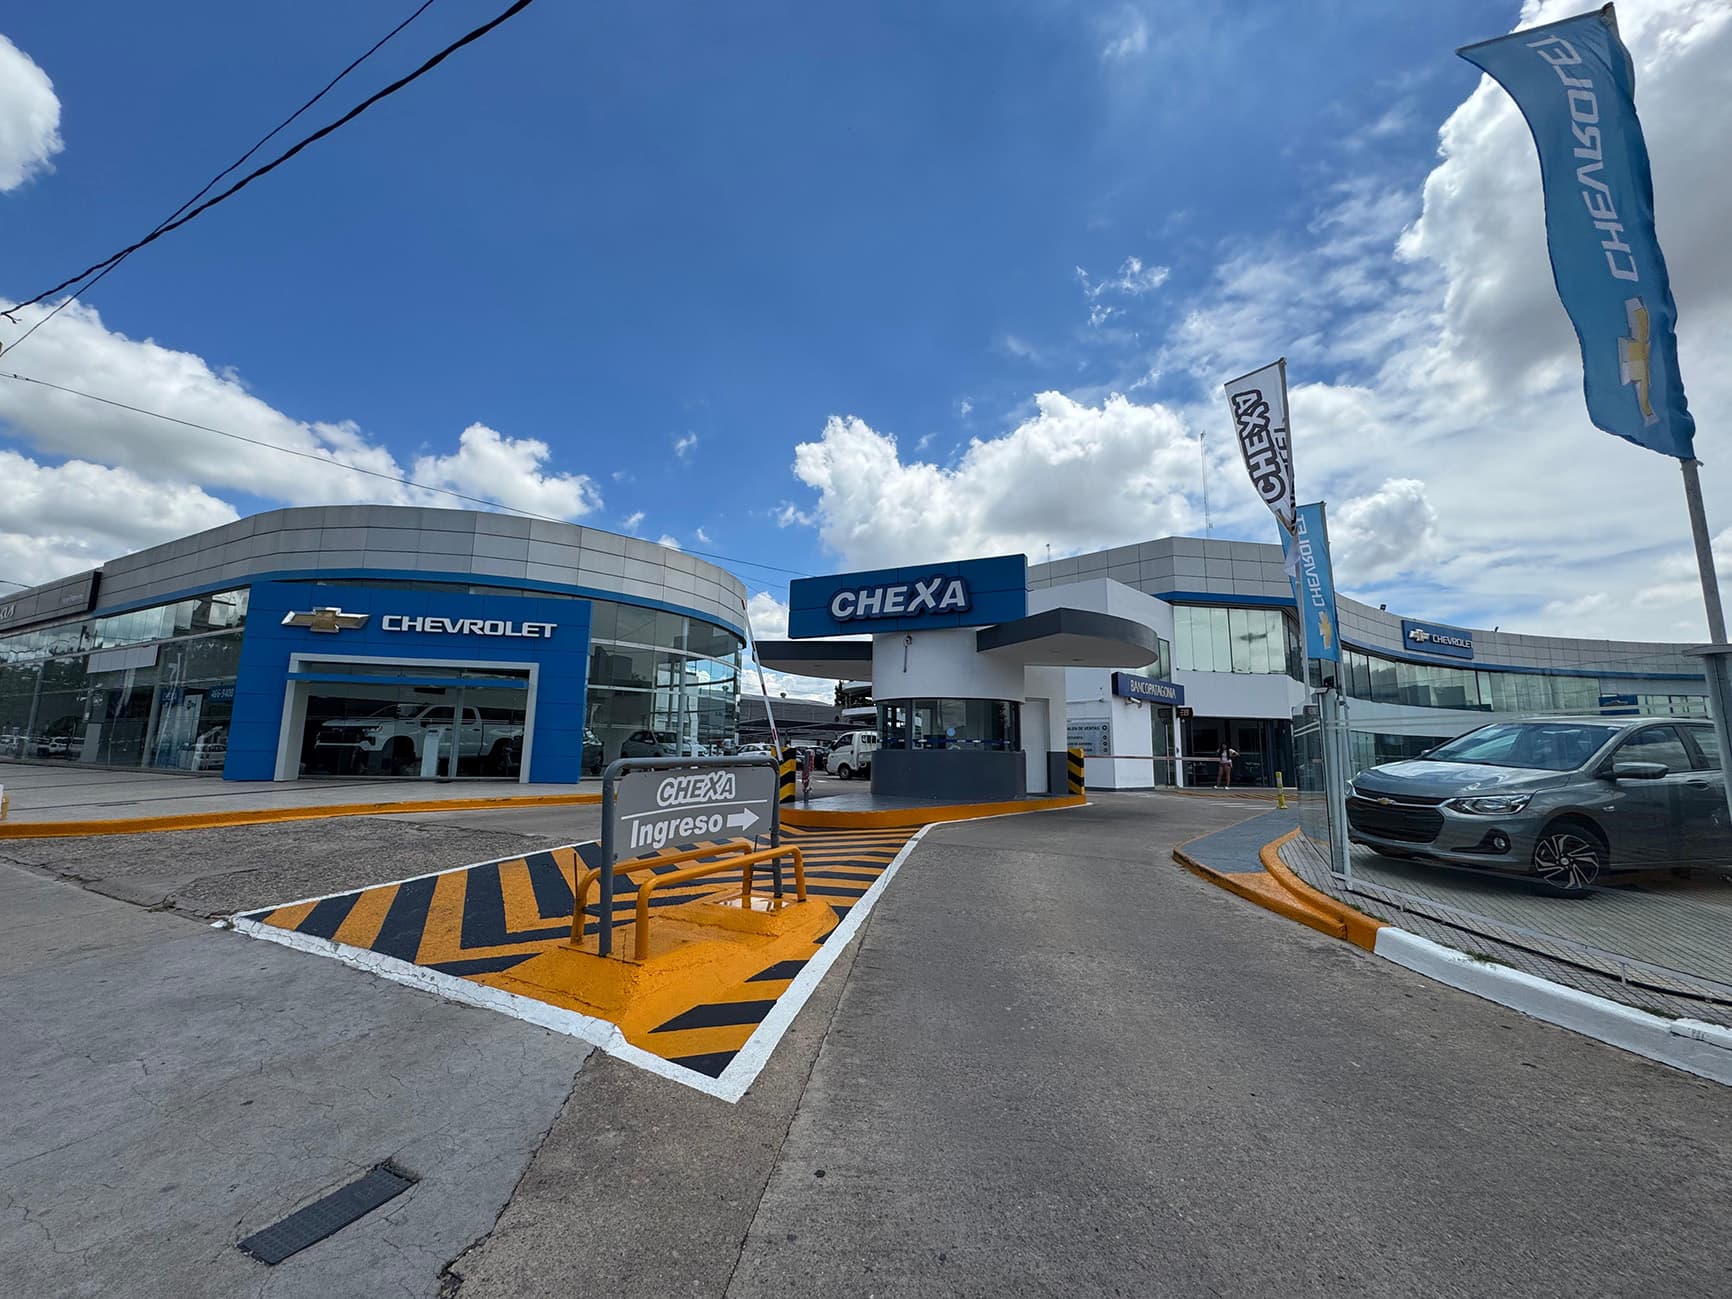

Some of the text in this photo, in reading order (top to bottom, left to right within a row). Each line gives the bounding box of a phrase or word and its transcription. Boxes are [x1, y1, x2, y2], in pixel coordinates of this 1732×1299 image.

[831, 577, 966, 618] CHEXA
[381, 614, 558, 639] CHEVROLET
[1432, 634, 1473, 649] CHEVROLET
[656, 770, 736, 807] CHEXA
[630, 814, 723, 849] Ingreso
